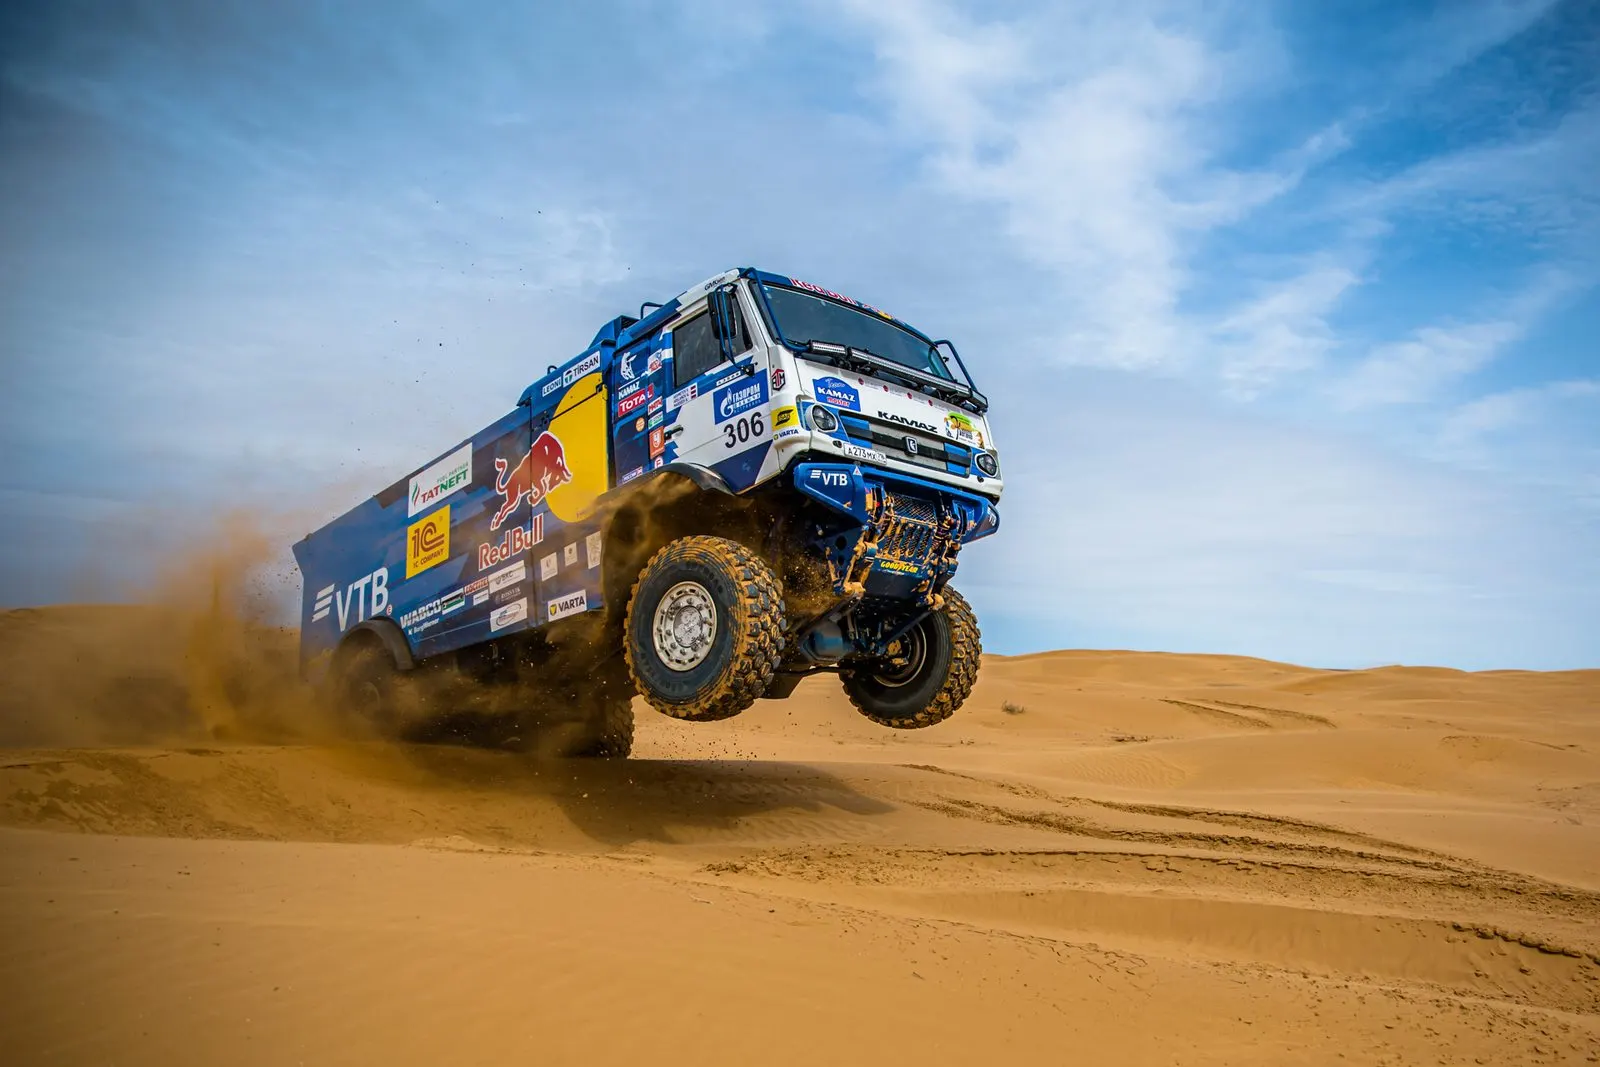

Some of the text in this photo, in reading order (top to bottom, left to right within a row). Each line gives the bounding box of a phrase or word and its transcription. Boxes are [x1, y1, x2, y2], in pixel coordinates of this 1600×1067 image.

[543, 378, 561, 395] LEONI
[618, 381, 639, 400] KAMAZ
[732, 382, 761, 403] ГАЗПРОМ
[817, 386, 855, 402] KAMAZ
[620, 390, 653, 413] TOTAL
[723, 412, 764, 448] 306
[878, 410, 938, 433] KAMAZ
[779, 429, 799, 438] VARTA
[421, 468, 468, 503] TATNEFT
[822, 473, 848, 486] VTB
[412, 521, 445, 559] 1C
[479, 512, 544, 572] Red Bull
[420, 548, 444, 565] COMPANY
[880, 560, 919, 573] GOODYEAR
[336, 566, 389, 632] VTB
[558, 596, 586, 612] VARTA
[400, 598, 442, 629] WABCO
